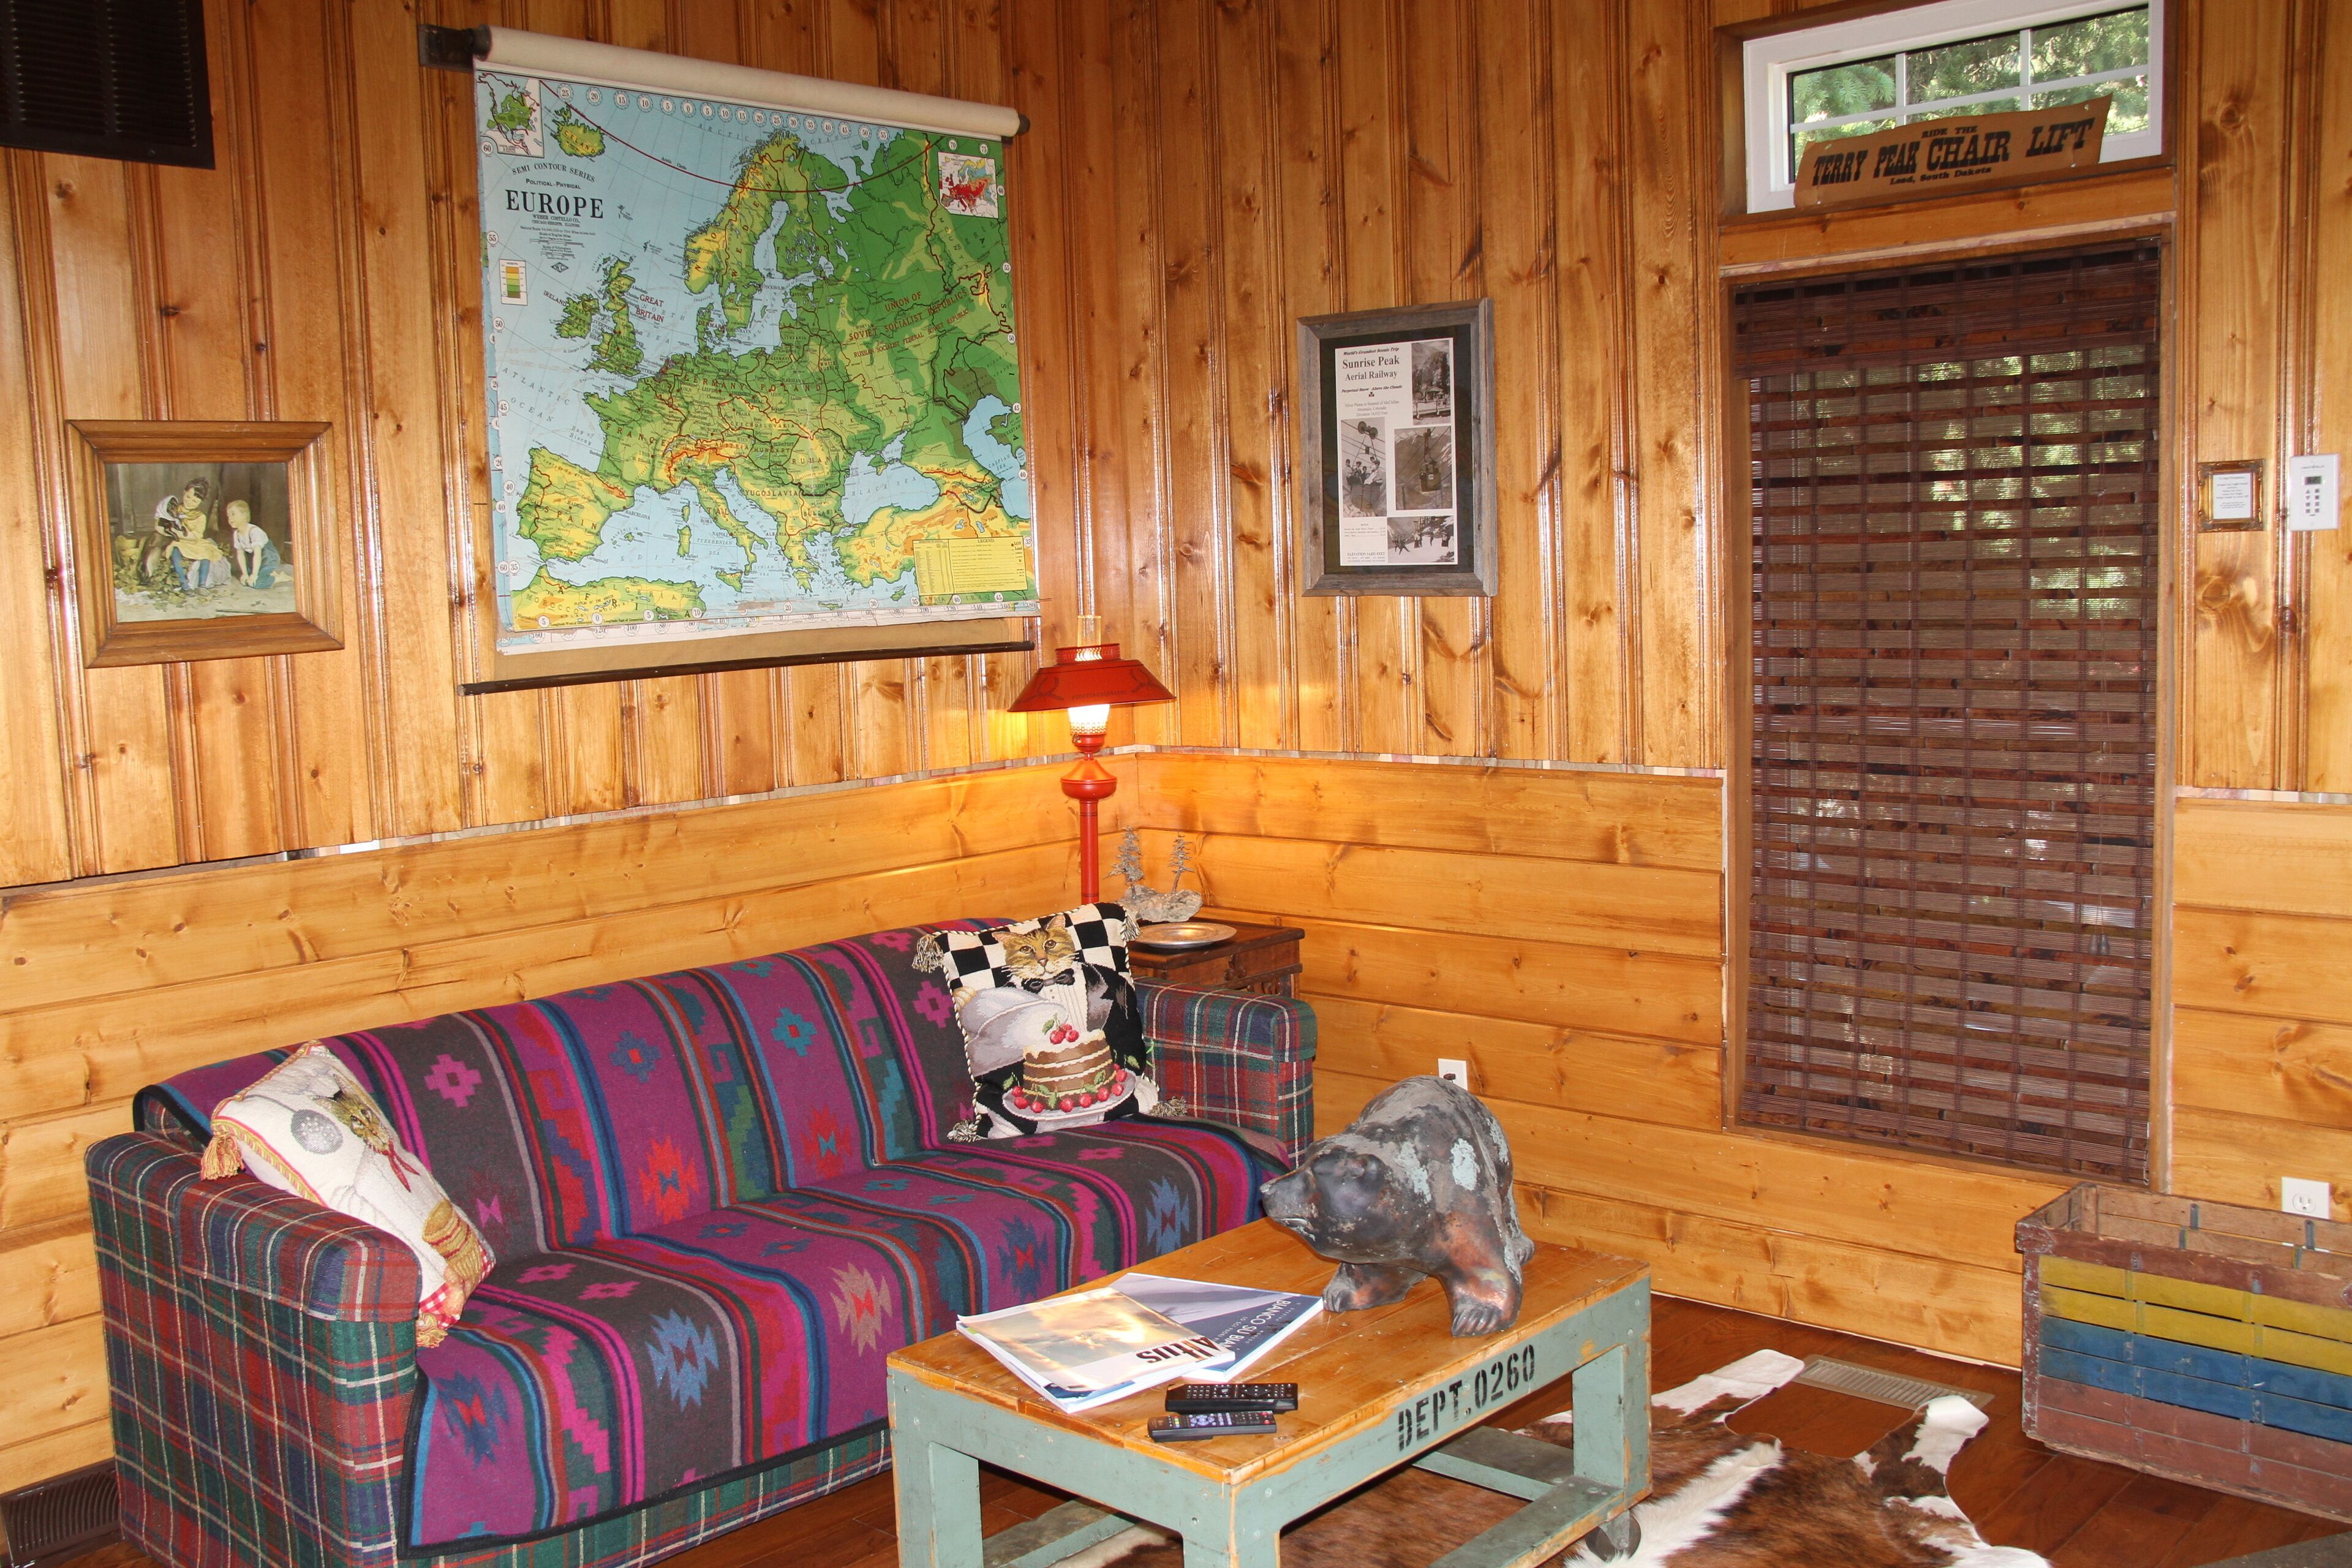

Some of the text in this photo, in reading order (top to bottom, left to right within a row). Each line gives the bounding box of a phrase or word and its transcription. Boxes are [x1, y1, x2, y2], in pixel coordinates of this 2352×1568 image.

[590, 92, 598, 101] 20
[699, 124, 839, 145] ARCTIC OCEAN
[1921, 126, 1978, 138] RIDE THE
[1812, 117, 2095, 186] TERRY PEAK CHAIR LIFT
[512, 162, 595, 183] SEMI CONTOUR SERIES
[1920, 172, 1950, 182] South
[505, 189, 604, 219] EUROPE
[543, 290, 568, 306] IRELAND
[639, 294, 665, 307] GREAT
[885, 292, 921, 312] UNION OF
[636, 308, 665, 323] BRITAIN
[849, 290, 967, 341] SOVIET SOCIALIST REPUBLICS
[853, 349, 874, 358] RUSSIAN
[876, 341, 900, 353] SOCIALIST
[903, 333, 924, 344] FEDERAL
[947, 309, 969, 324] REPUBLIC
[1343, 355, 1400, 369] Sunrise Peak
[684, 374, 747, 390] GERMANY
[1345, 370, 1398, 381] Aerial Railway
[502, 368, 570, 405] ATLANTIC
[511, 397, 554, 421] OCEAN
[572, 425, 583, 434] Bay
[606, 423, 666, 447] FRANCE
[570, 434, 592, 446] Biscay
[989, 454, 1011, 469] CASPIAN
[852, 476, 916, 496] BLACK SEA
[545, 506, 597, 530] SPAIN
[625, 510, 650, 520] BARCELONA
[526, 593, 579, 614] MOROCCO
[1250, 1300, 1292, 1325] BIANCO
[1237, 1325, 1257, 1335] SU
[1136, 1336, 1221, 1363] Altus
